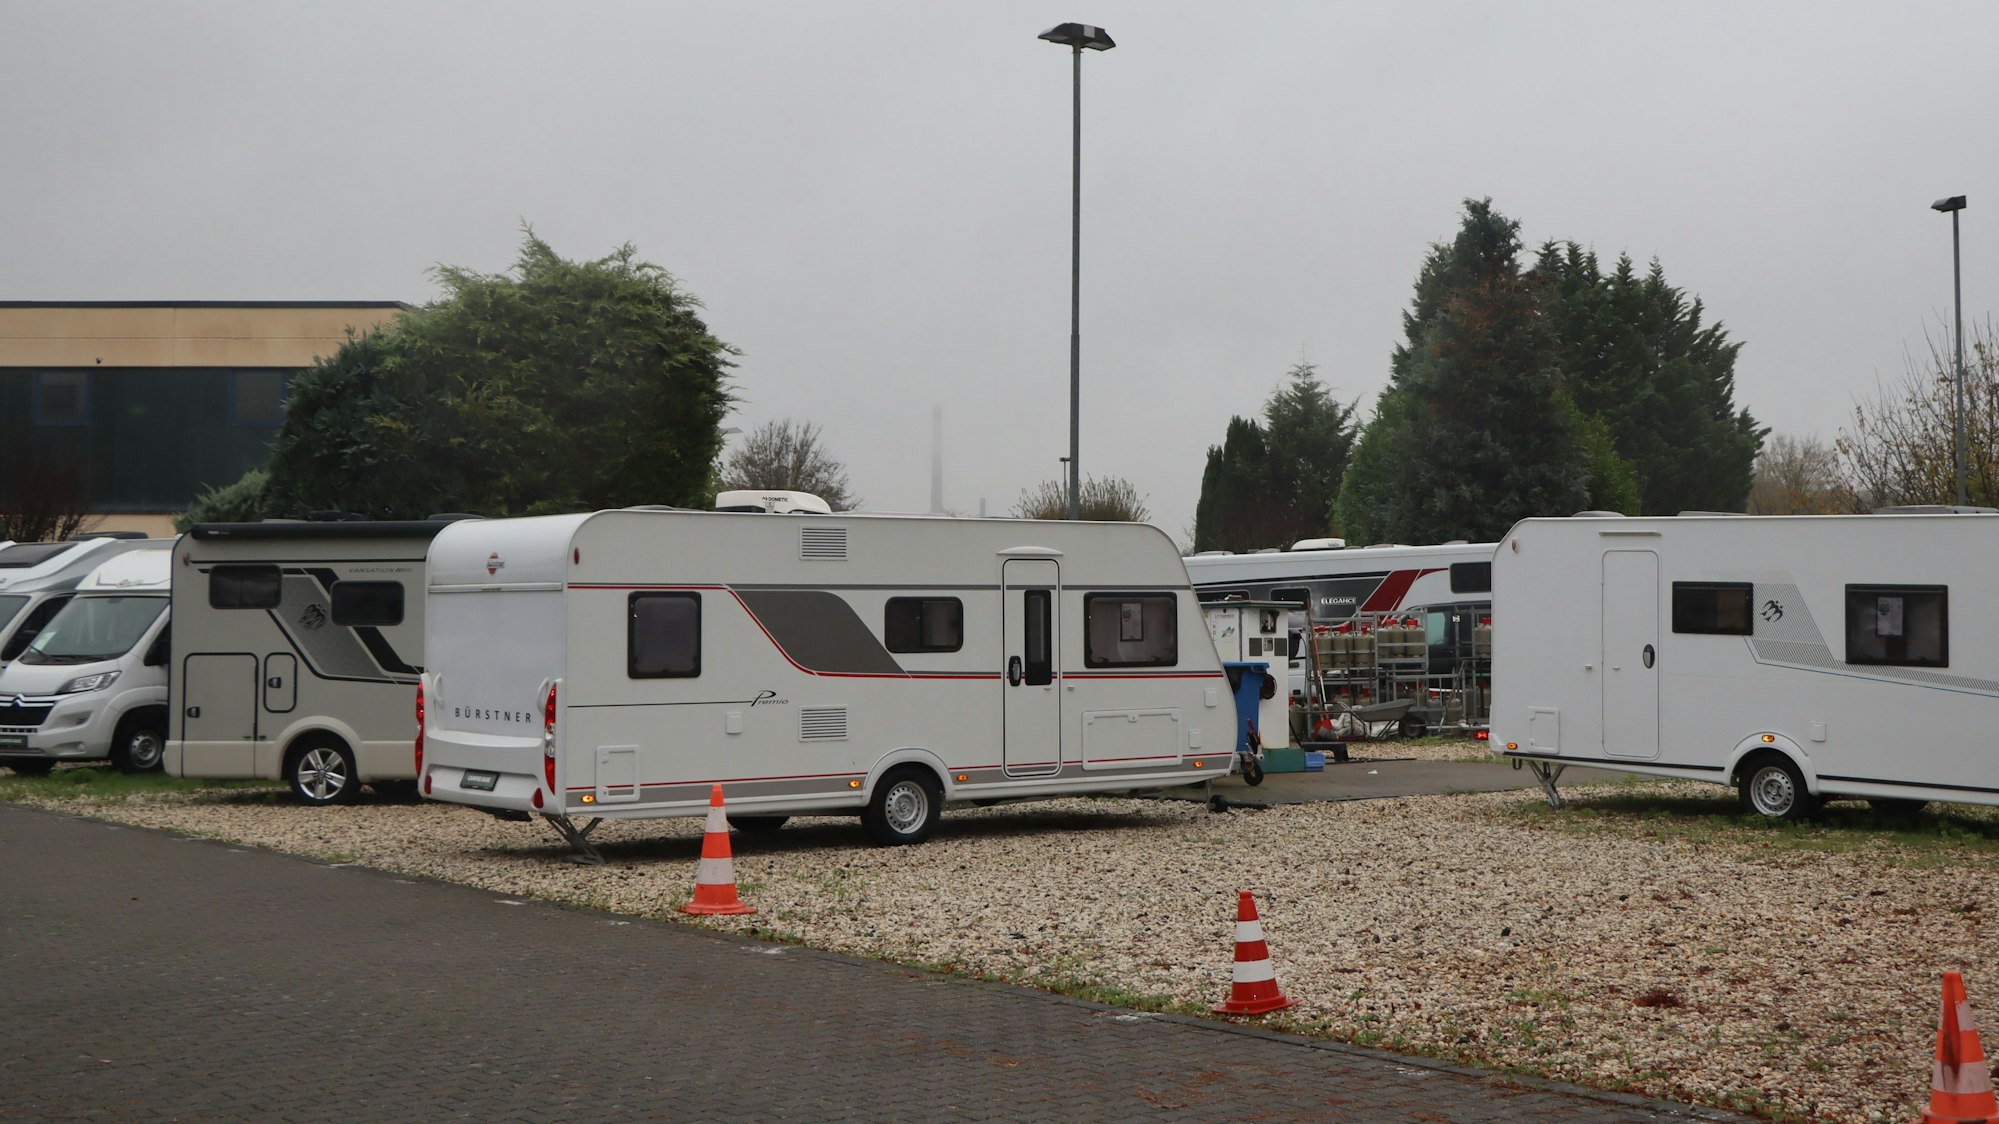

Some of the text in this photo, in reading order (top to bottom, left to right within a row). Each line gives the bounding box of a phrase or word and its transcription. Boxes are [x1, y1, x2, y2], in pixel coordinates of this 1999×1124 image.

[1320, 597, 1357, 605] ELEGANCE
[751, 690, 789, 707] Premio
[455, 706, 532, 723] BÜRSTNER
